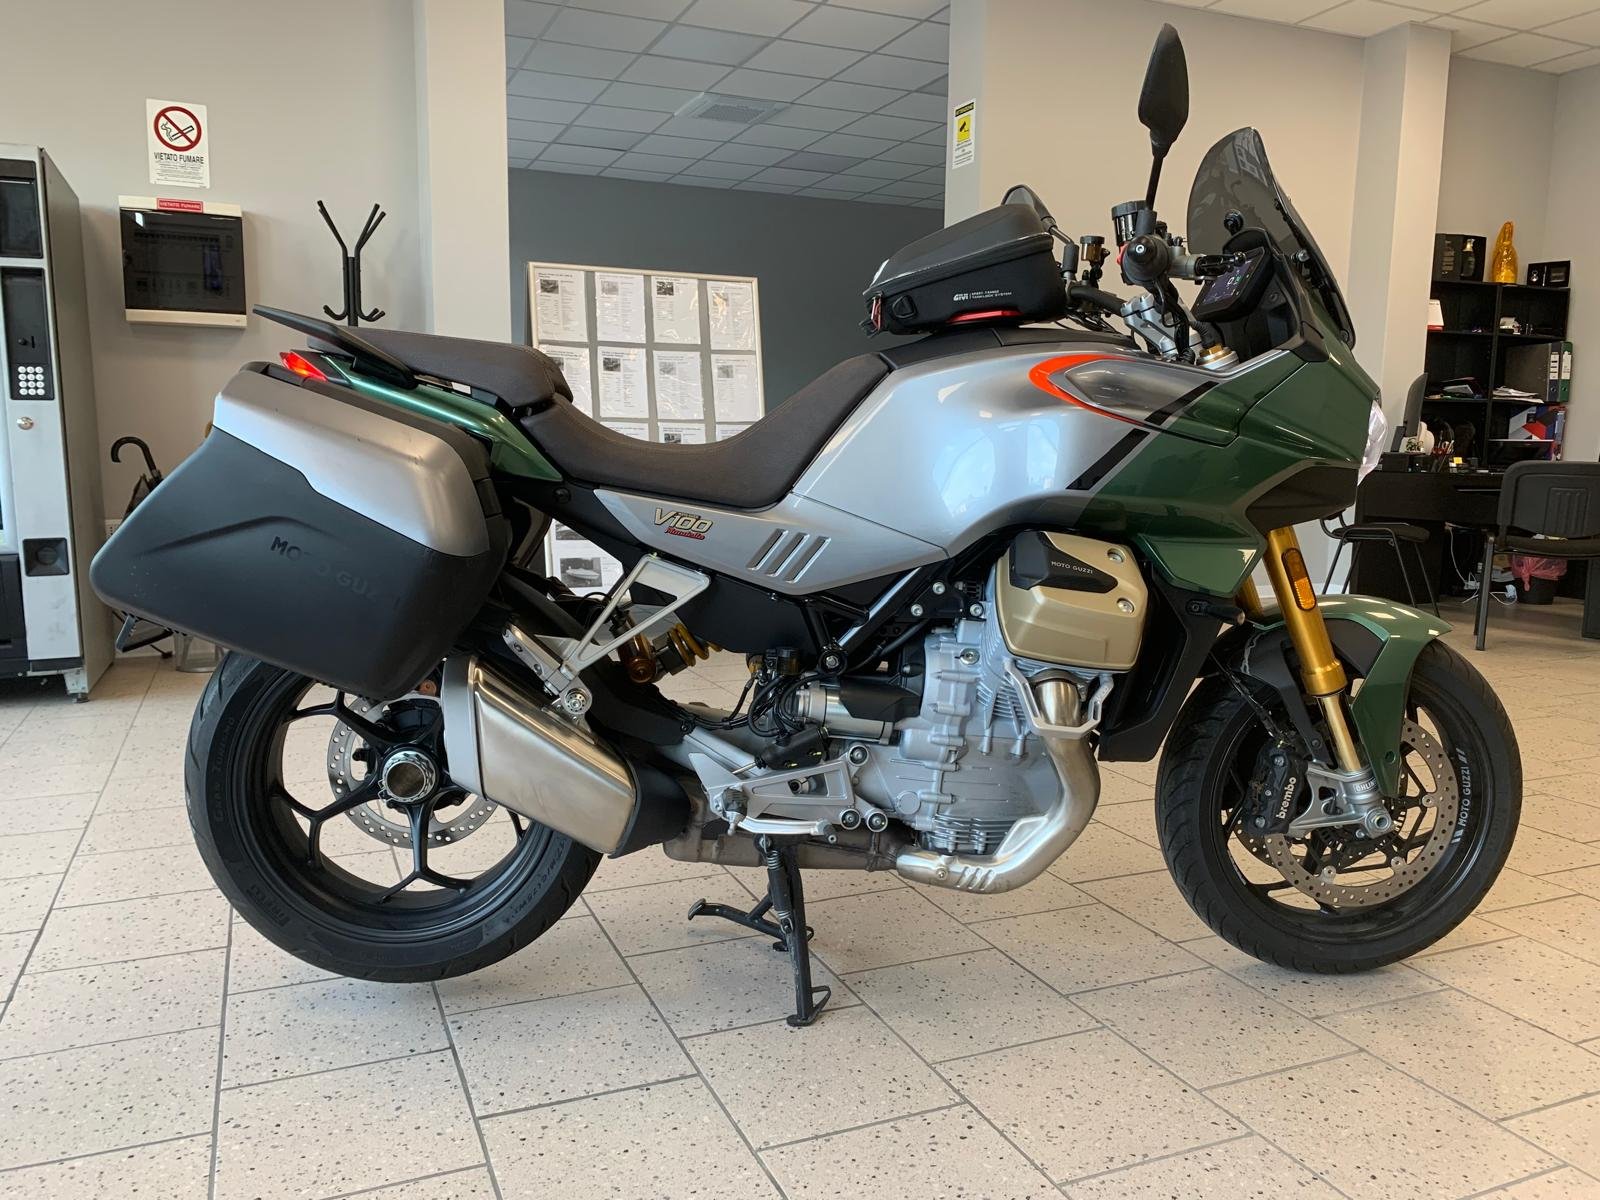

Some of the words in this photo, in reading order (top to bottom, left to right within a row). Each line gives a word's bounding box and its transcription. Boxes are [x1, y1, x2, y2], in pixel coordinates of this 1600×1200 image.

[154, 152, 178, 162] VIETATO
[179, 155, 204, 164] FUMARE
[953, 293, 968, 301] GIVI
[654, 507, 714, 533] V100
[1051, 561, 1071, 569] MOTO
[1072, 565, 1093, 574] GUZZI
[1461, 766, 1471, 796] GUZZI
[1275, 777, 1297, 819] brembo
[1457, 798, 1471, 827] MOTO
